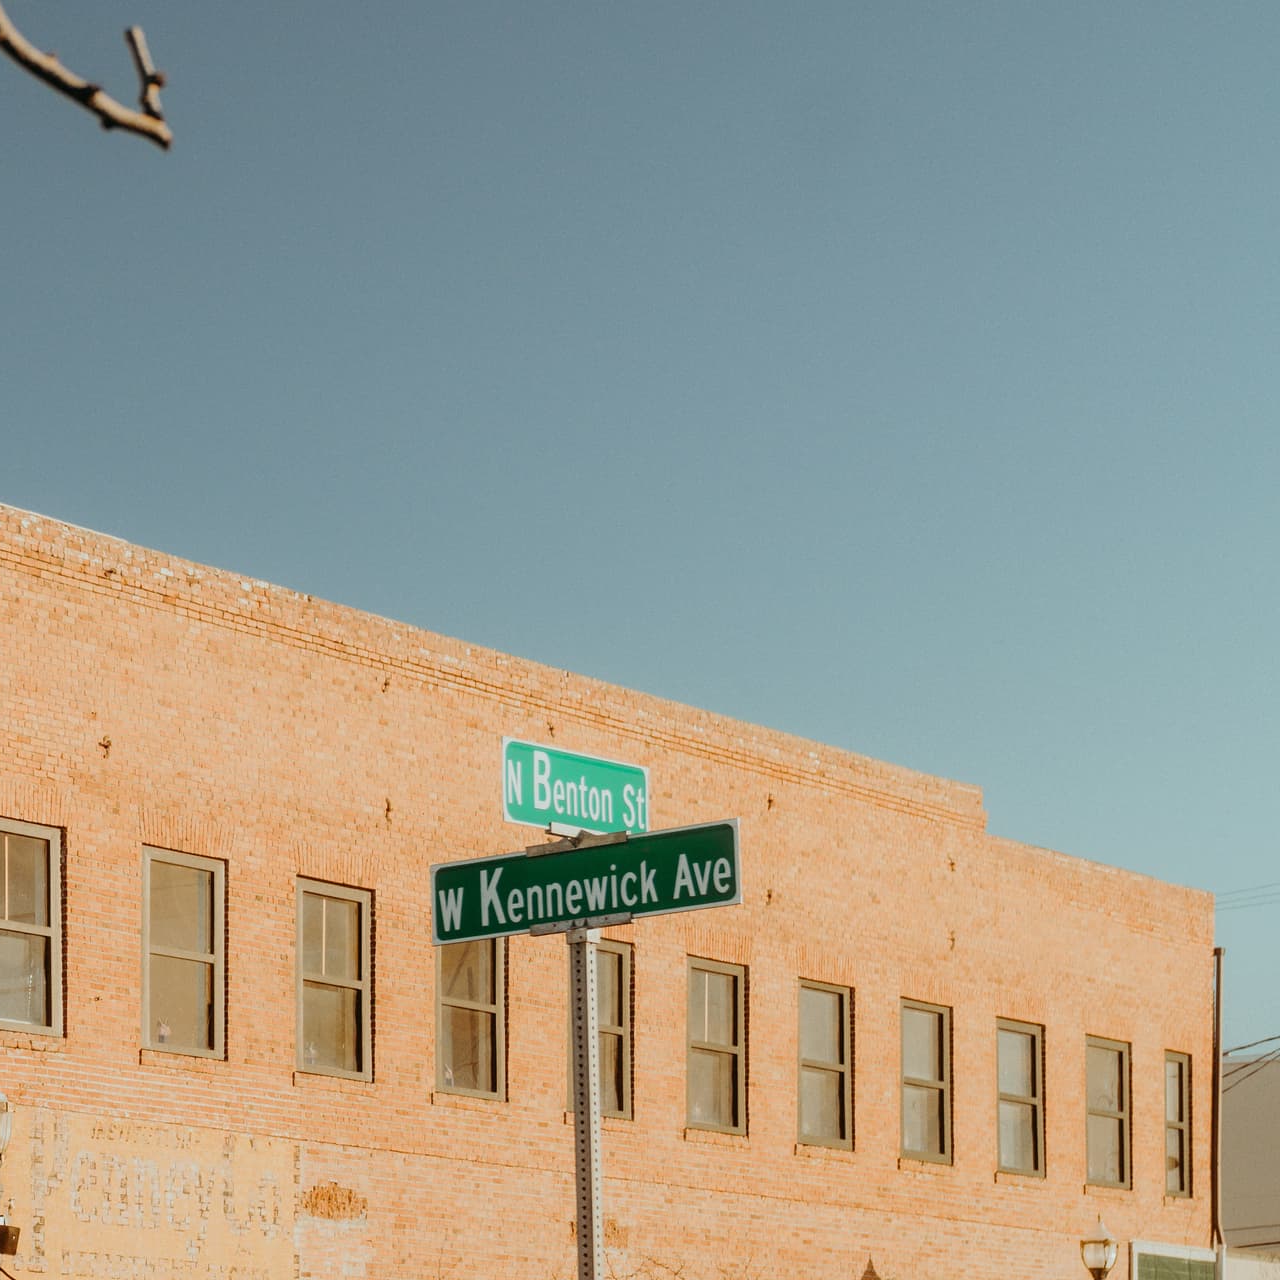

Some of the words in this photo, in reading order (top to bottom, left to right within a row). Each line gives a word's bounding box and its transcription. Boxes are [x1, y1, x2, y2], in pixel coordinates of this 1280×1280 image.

[507, 760, 523, 806] N
[533, 751, 614, 823] Benton
[622, 784, 646, 829] St
[439, 887, 464, 932] W
[479, 860, 659, 928] Kennewick
[672, 853, 732, 900] Ave
